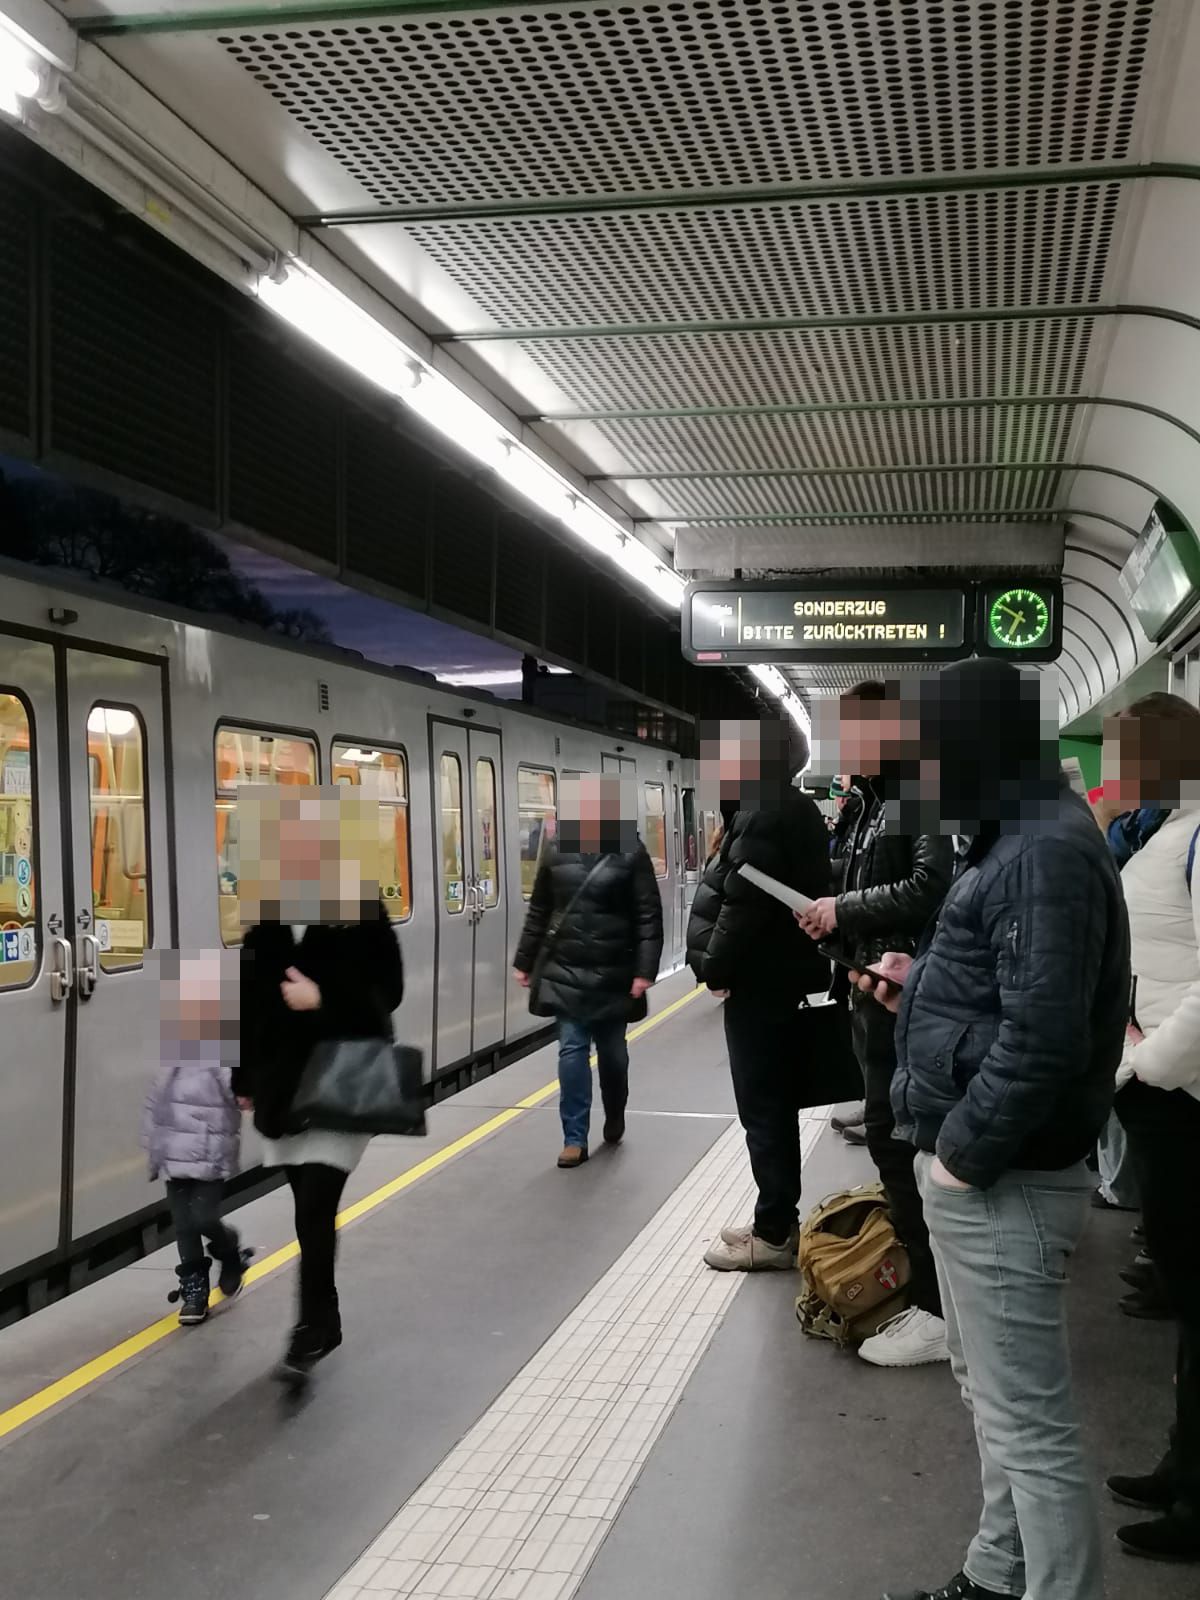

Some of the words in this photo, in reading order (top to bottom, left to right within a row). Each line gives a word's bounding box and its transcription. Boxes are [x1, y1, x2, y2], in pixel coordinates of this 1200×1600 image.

[794, 601, 887, 616] SONDERZUG
[743, 625, 794, 640] BITTE
[803, 622, 928, 640] ZURÜCKTRETEN
[939, 624, 945, 639] !
